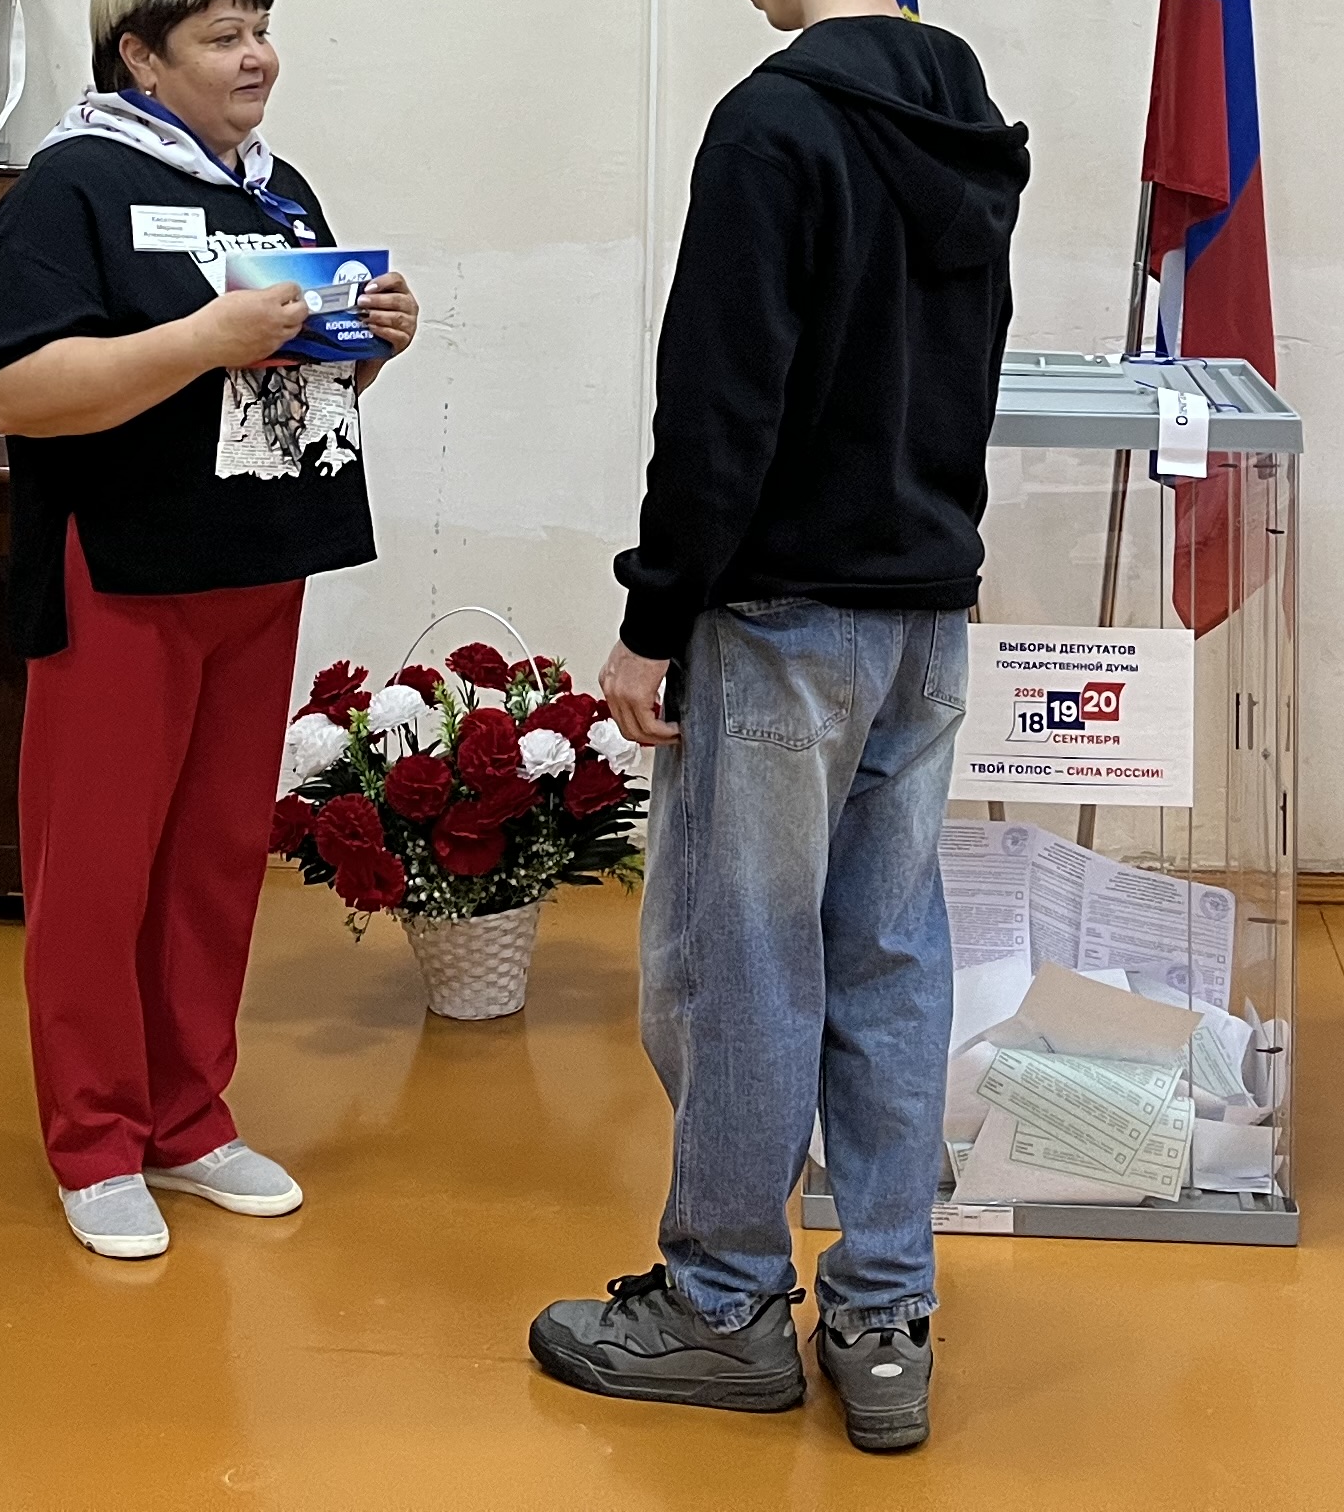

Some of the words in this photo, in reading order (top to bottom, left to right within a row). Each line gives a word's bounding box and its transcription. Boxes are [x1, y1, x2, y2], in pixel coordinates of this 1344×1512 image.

[325, 320, 367, 331] КОСТРОМ
[337, 330, 374, 341] ОБЛАСТЬ
[999, 642, 1056, 653] ВЫБОРЫ
[1059, 643, 1136, 655] ДЕПУТАТОВ
[996, 660, 1103, 671] ГОСУДАРСТВЕННОЙ
[1105, 662, 1139, 673] ДУМЫ
[1014, 688, 1045, 698] 2026
[1018, 712, 1044, 733] 18
[1050, 700, 1078, 723] 19
[1083, 690, 1117, 713] 20
[1052, 734, 1120, 745] СЕНТЯБРЯ
[970, 762, 1005, 774] ТВОЙ
[1008, 764, 1052, 775] ГОЛОС
[1066, 766, 1102, 777] СИЛА
[1106, 767, 1164, 778] РОССИИ!
